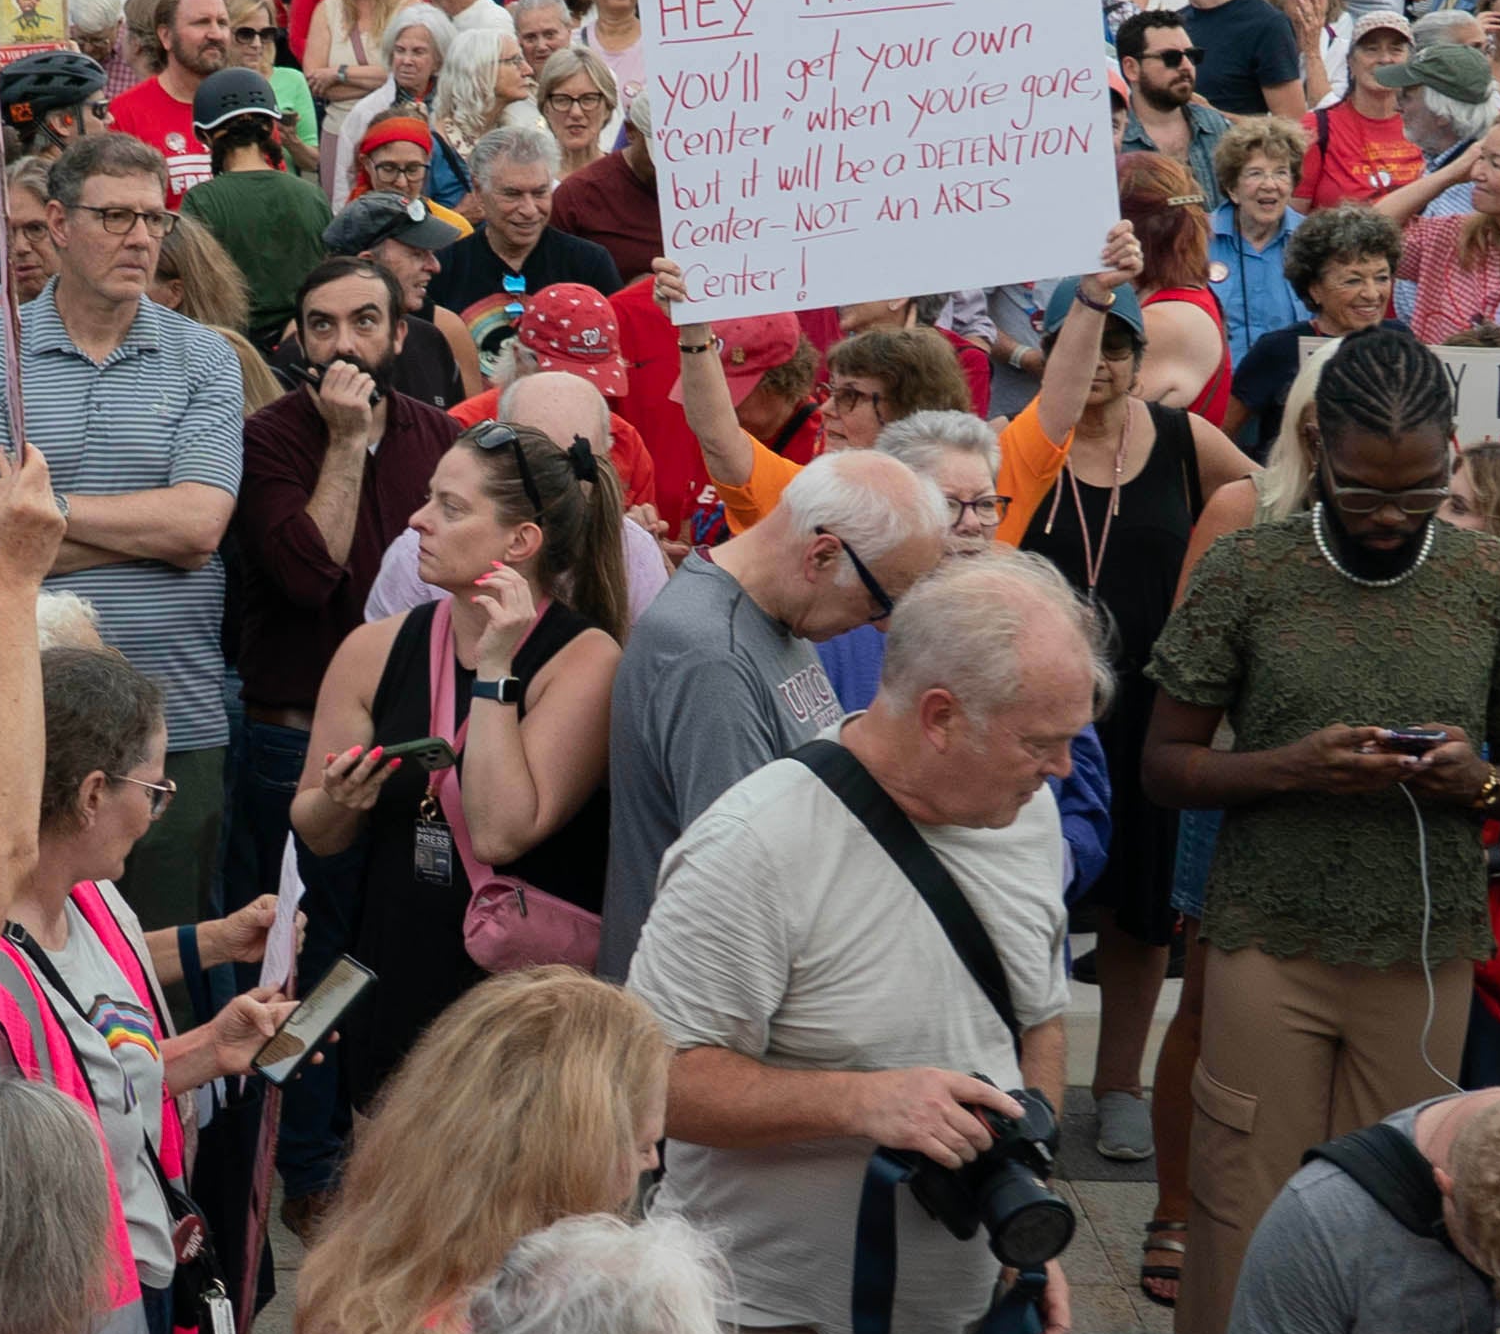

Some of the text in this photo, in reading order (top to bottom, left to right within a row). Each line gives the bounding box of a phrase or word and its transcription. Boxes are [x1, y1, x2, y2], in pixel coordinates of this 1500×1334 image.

[786, 28, 841, 103] get
[856, 35, 943, 95] your
[951, 21, 1032, 64] own
[806, 90, 894, 134] when
[671, 123, 1095, 213] but it will be a DETENTION
[932, 176, 1012, 217] ARTS
[777, 662, 834, 724] UNIO
[416, 825, 450, 837] NATIONAL
[416, 833, 450, 847] PRESS
